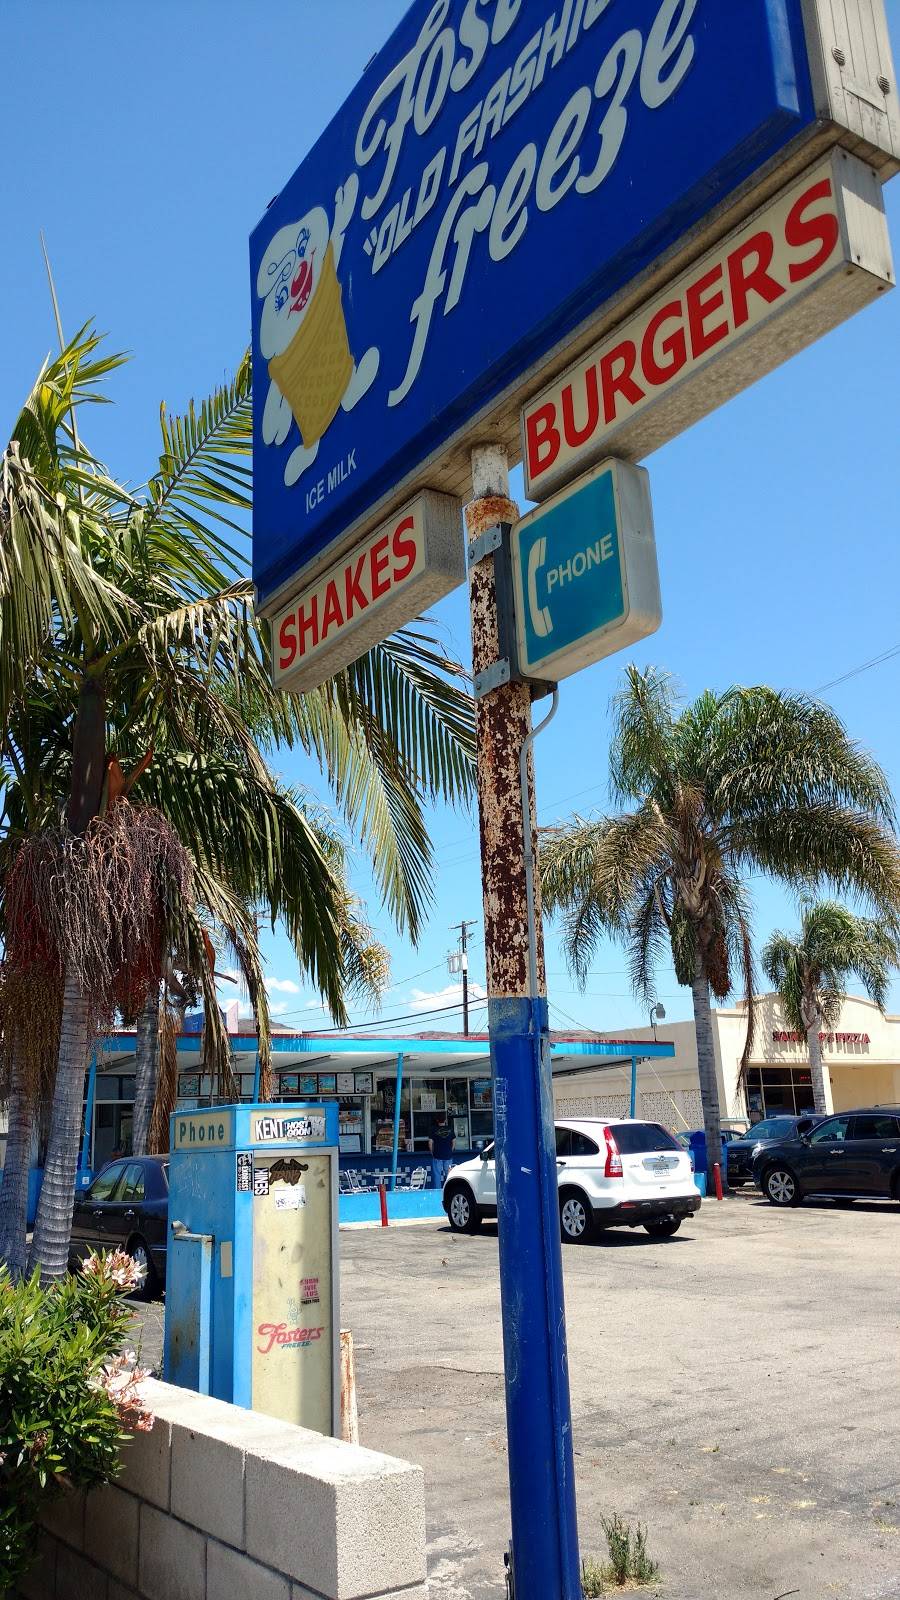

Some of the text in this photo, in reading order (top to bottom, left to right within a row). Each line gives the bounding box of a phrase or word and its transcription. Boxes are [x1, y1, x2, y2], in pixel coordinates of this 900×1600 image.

[525, 178, 840, 480] BURGERS
[304, 448, 358, 515] ICE MILK
[546, 532, 615, 594] PHONE
[279, 515, 418, 670] SHAKES
[835, 1032, 870, 1044] PIZZA
[179, 1121, 225, 1143] Phone
[255, 1118, 285, 1141] KENT
[253, 1167, 269, 1196] SENIK
[257, 1323, 324, 1354] Fosters
